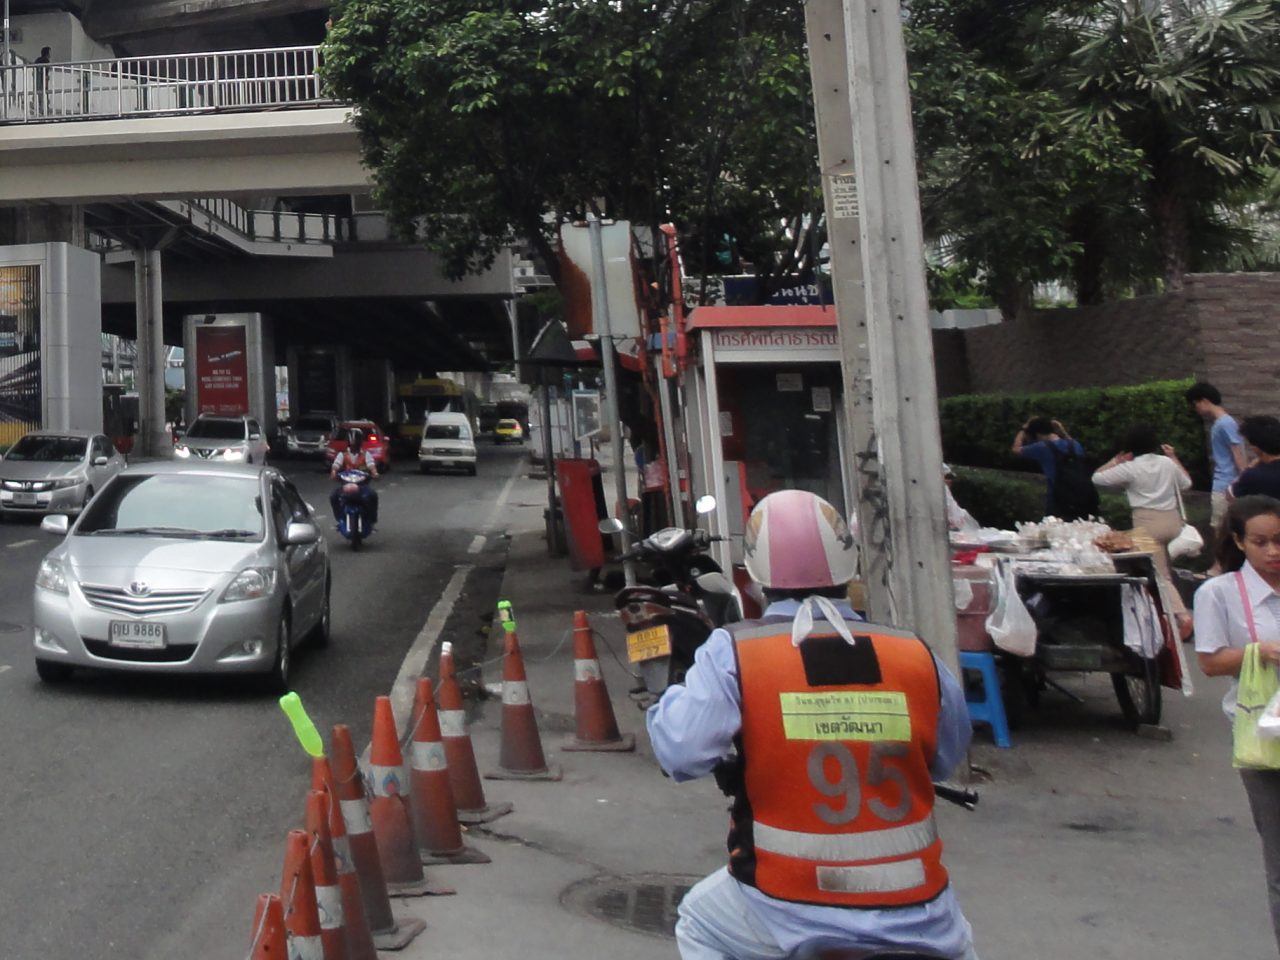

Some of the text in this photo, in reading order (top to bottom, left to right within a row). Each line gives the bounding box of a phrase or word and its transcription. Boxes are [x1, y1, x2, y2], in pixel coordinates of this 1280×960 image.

[715, 330, 839, 347] โทรศัพท์สาธารณ
[133, 624, 162, 637] 9886
[815, 715, 884, 735] เขตวัฒนา
[807, 741, 913, 826] 95
